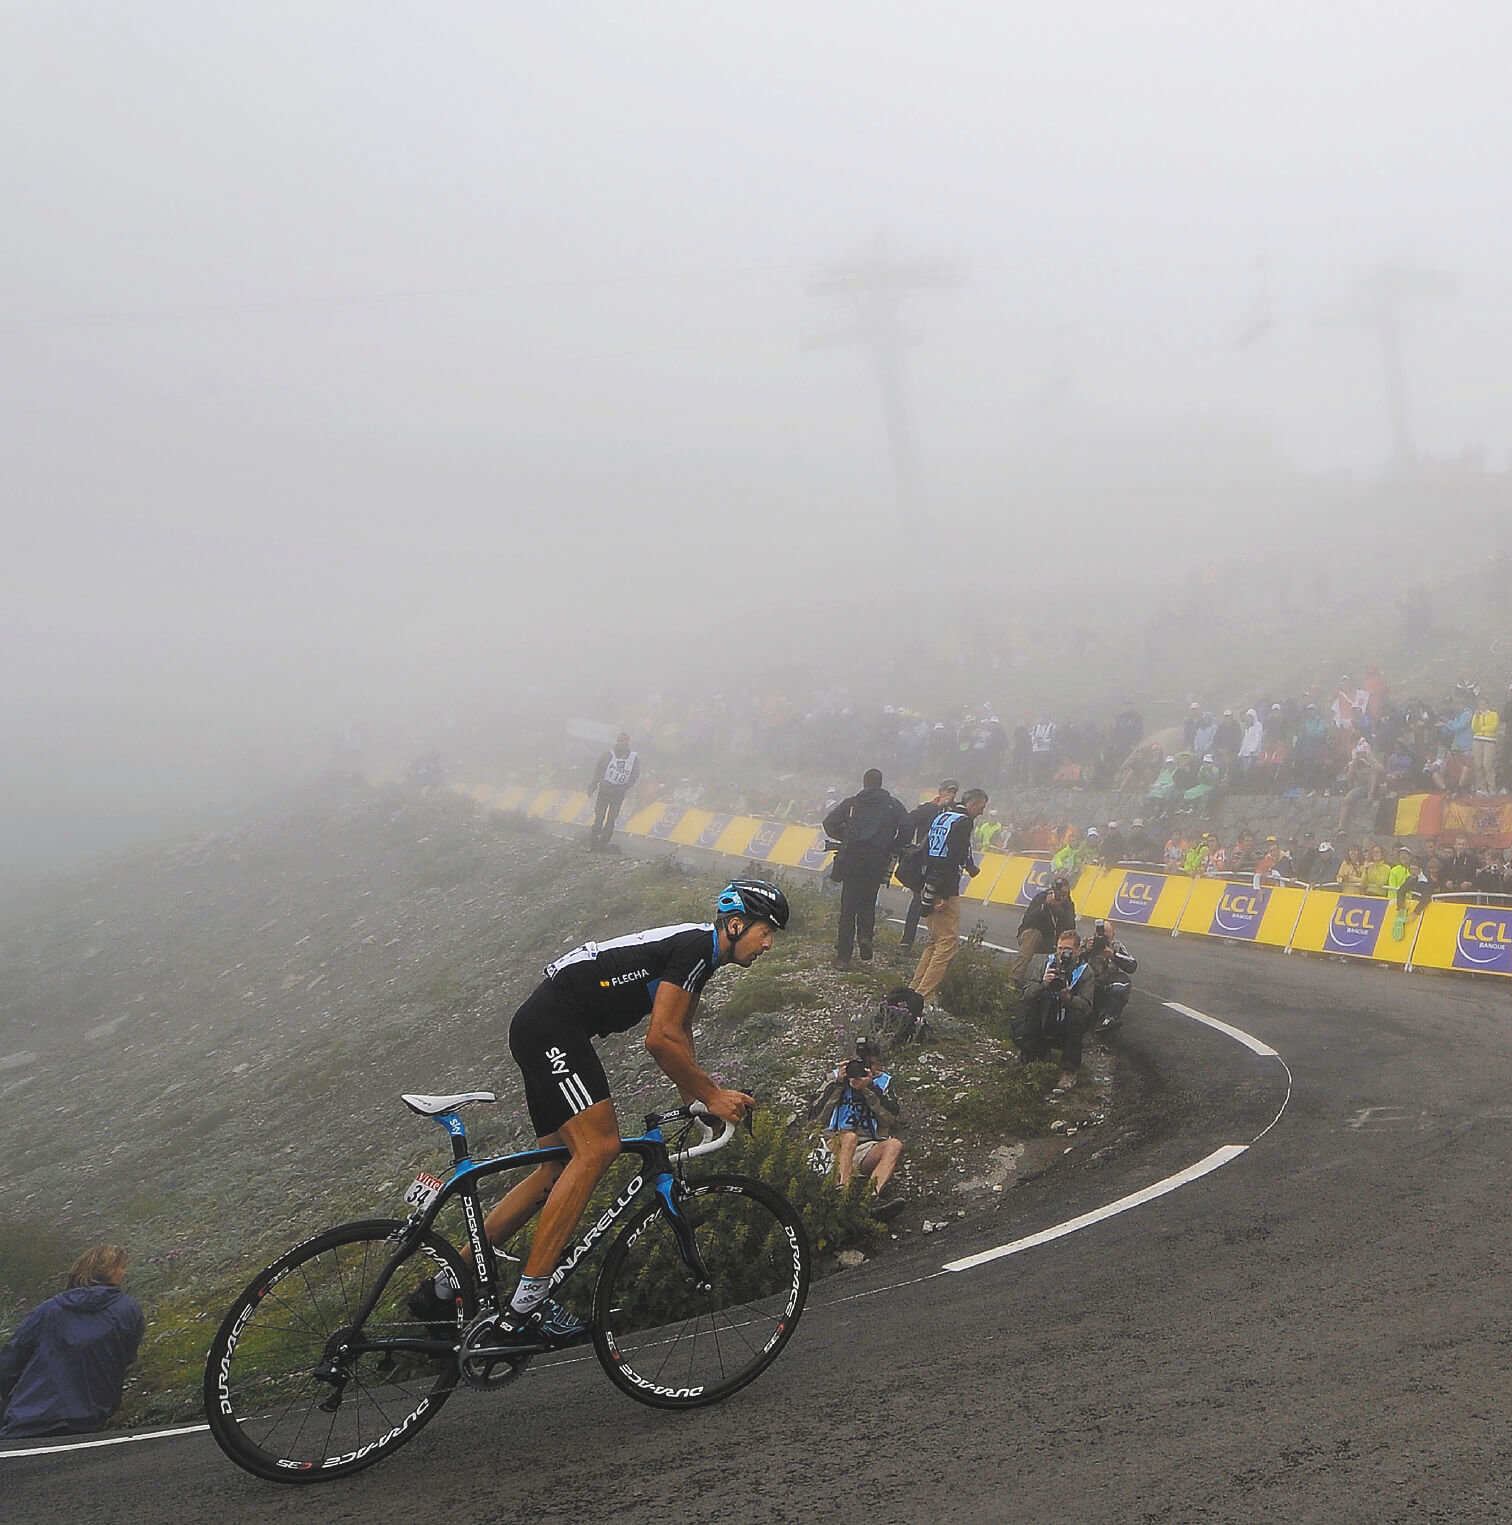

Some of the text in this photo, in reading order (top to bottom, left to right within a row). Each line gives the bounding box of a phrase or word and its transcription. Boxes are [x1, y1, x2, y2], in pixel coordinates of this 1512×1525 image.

[1120, 882, 1153, 900] LCL
[1221, 894, 1259, 915] LCL
[1334, 907, 1375, 930] LCL
[1346, 926, 1370, 936] BANQUE
[1462, 919, 1512, 944] LCL
[1479, 942, 1506, 951] BANQUE
[611, 968, 650, 987] FLECHA
[546, 1046, 570, 1075] sky
[407, 1184, 431, 1208] 34
[218, 1303, 253, 1416] DURA-ACE
[618, 1363, 704, 1398] DURA-ACE
[321, 1398, 430, 1469] DURA-ACE
